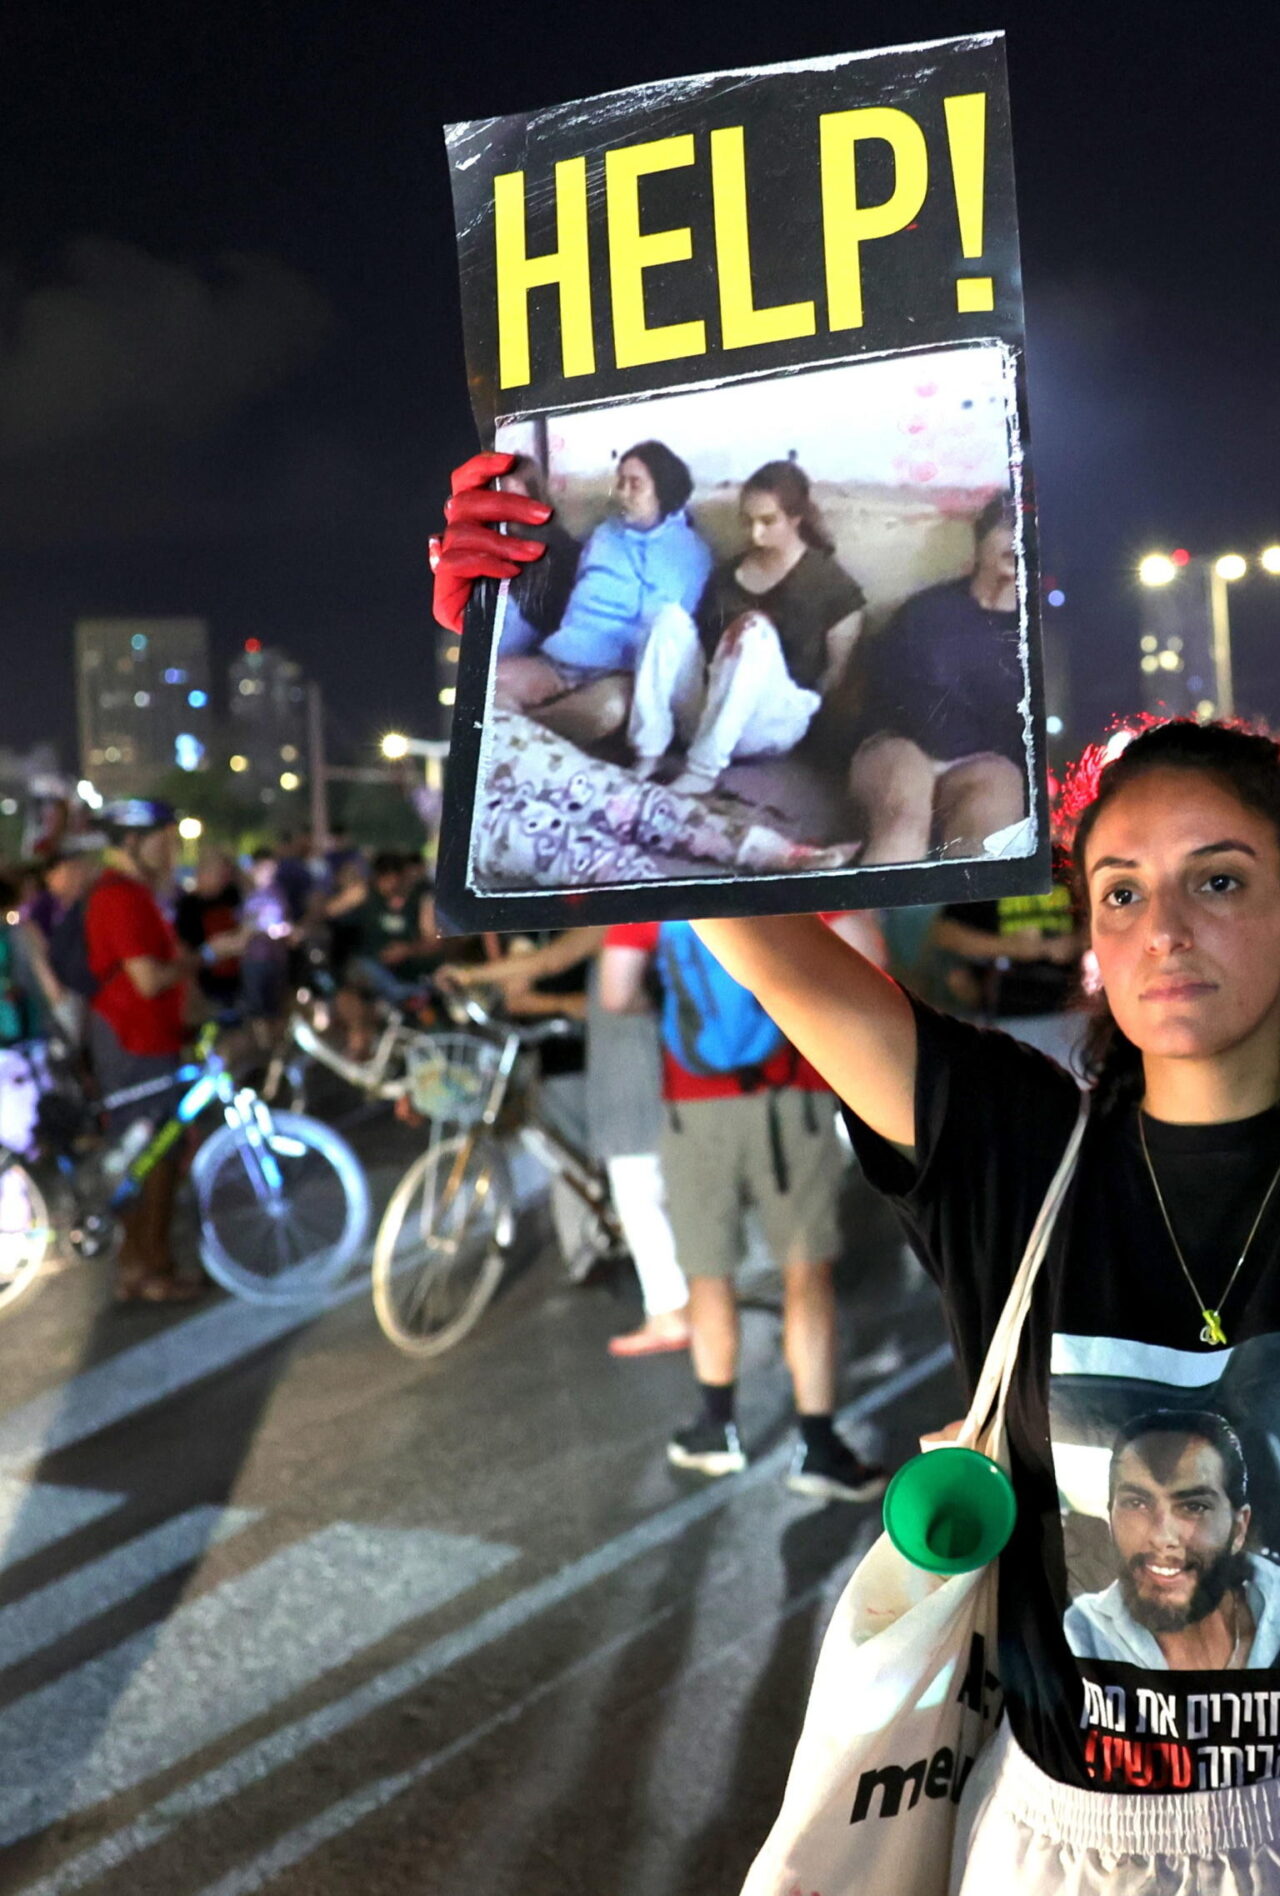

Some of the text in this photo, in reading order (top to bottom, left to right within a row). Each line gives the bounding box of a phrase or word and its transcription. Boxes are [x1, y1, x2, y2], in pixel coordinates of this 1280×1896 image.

[494, 92, 994, 390] HELP!
[1079, 1676, 1127, 1733] מתן
[1134, 1687, 1179, 1739] את
[1084, 1729, 1194, 1790] עכשיו!
